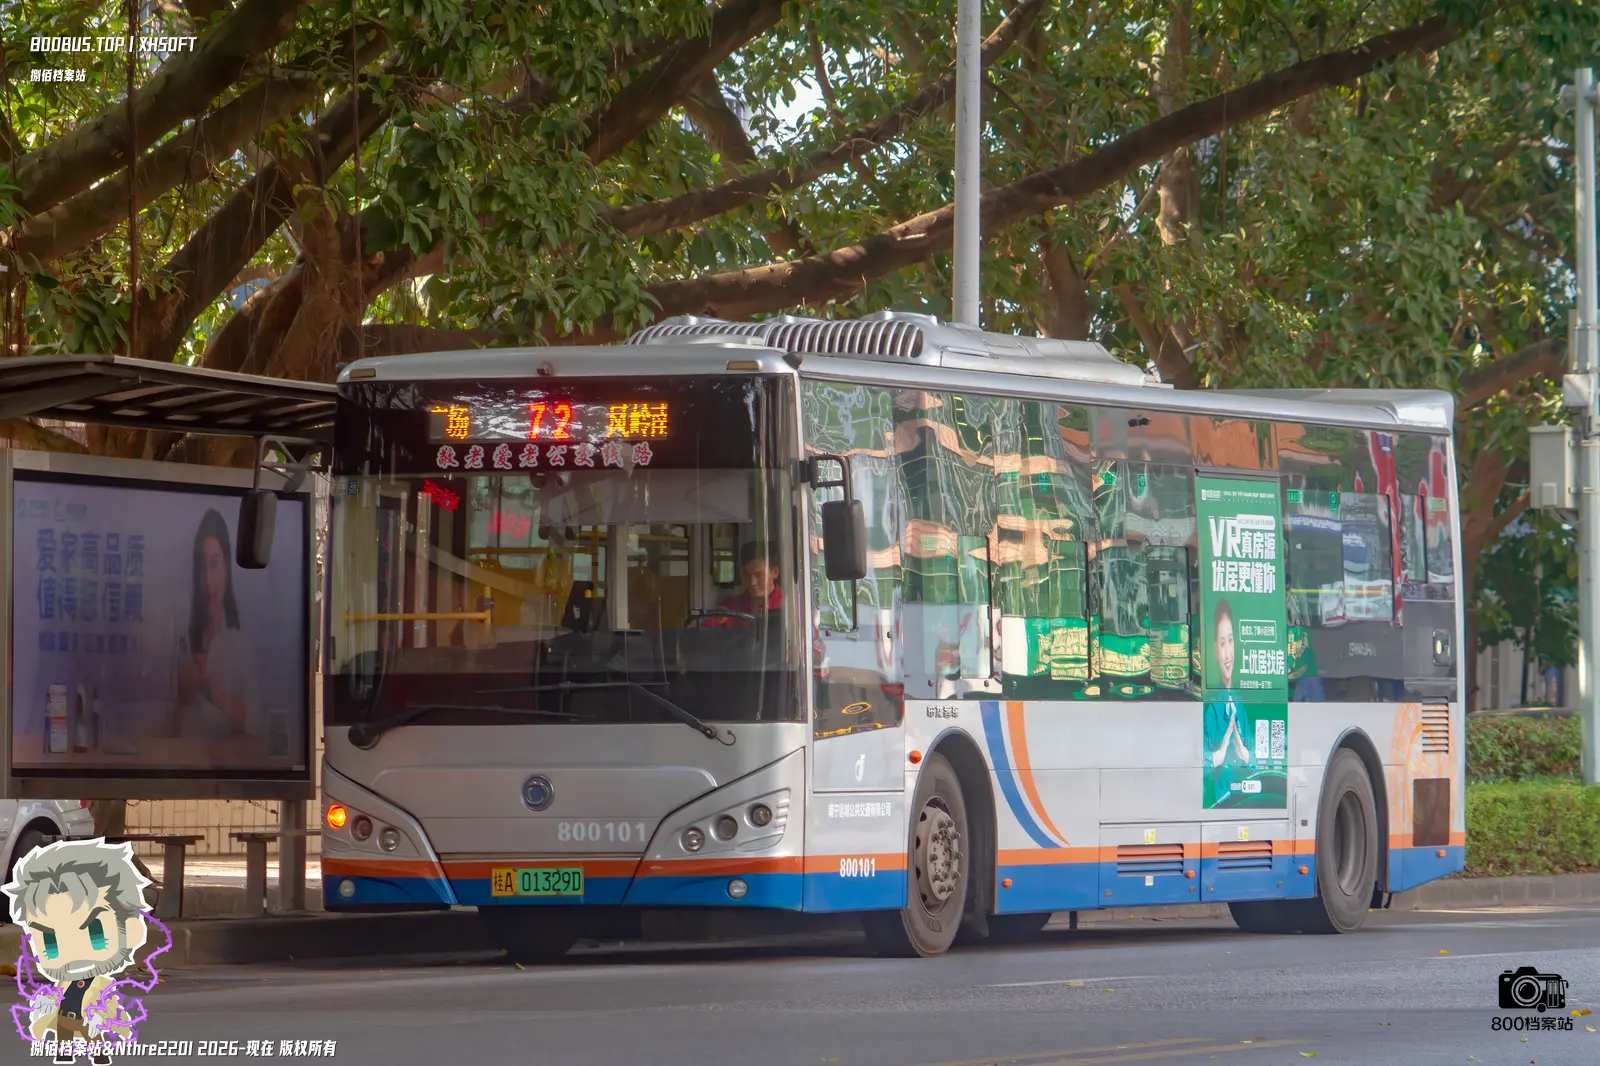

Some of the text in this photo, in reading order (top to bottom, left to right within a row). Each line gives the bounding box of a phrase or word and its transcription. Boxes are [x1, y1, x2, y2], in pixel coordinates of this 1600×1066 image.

[529, 403, 573, 439] 72
[436, 442, 653, 469] 敬老爱老公交线路
[1211, 560, 1276, 594] 优居更懂你
[1240, 648, 1285, 675] 上优居找房
[557, 822, 646, 842] 800101
[840, 857, 876, 878] 800101
